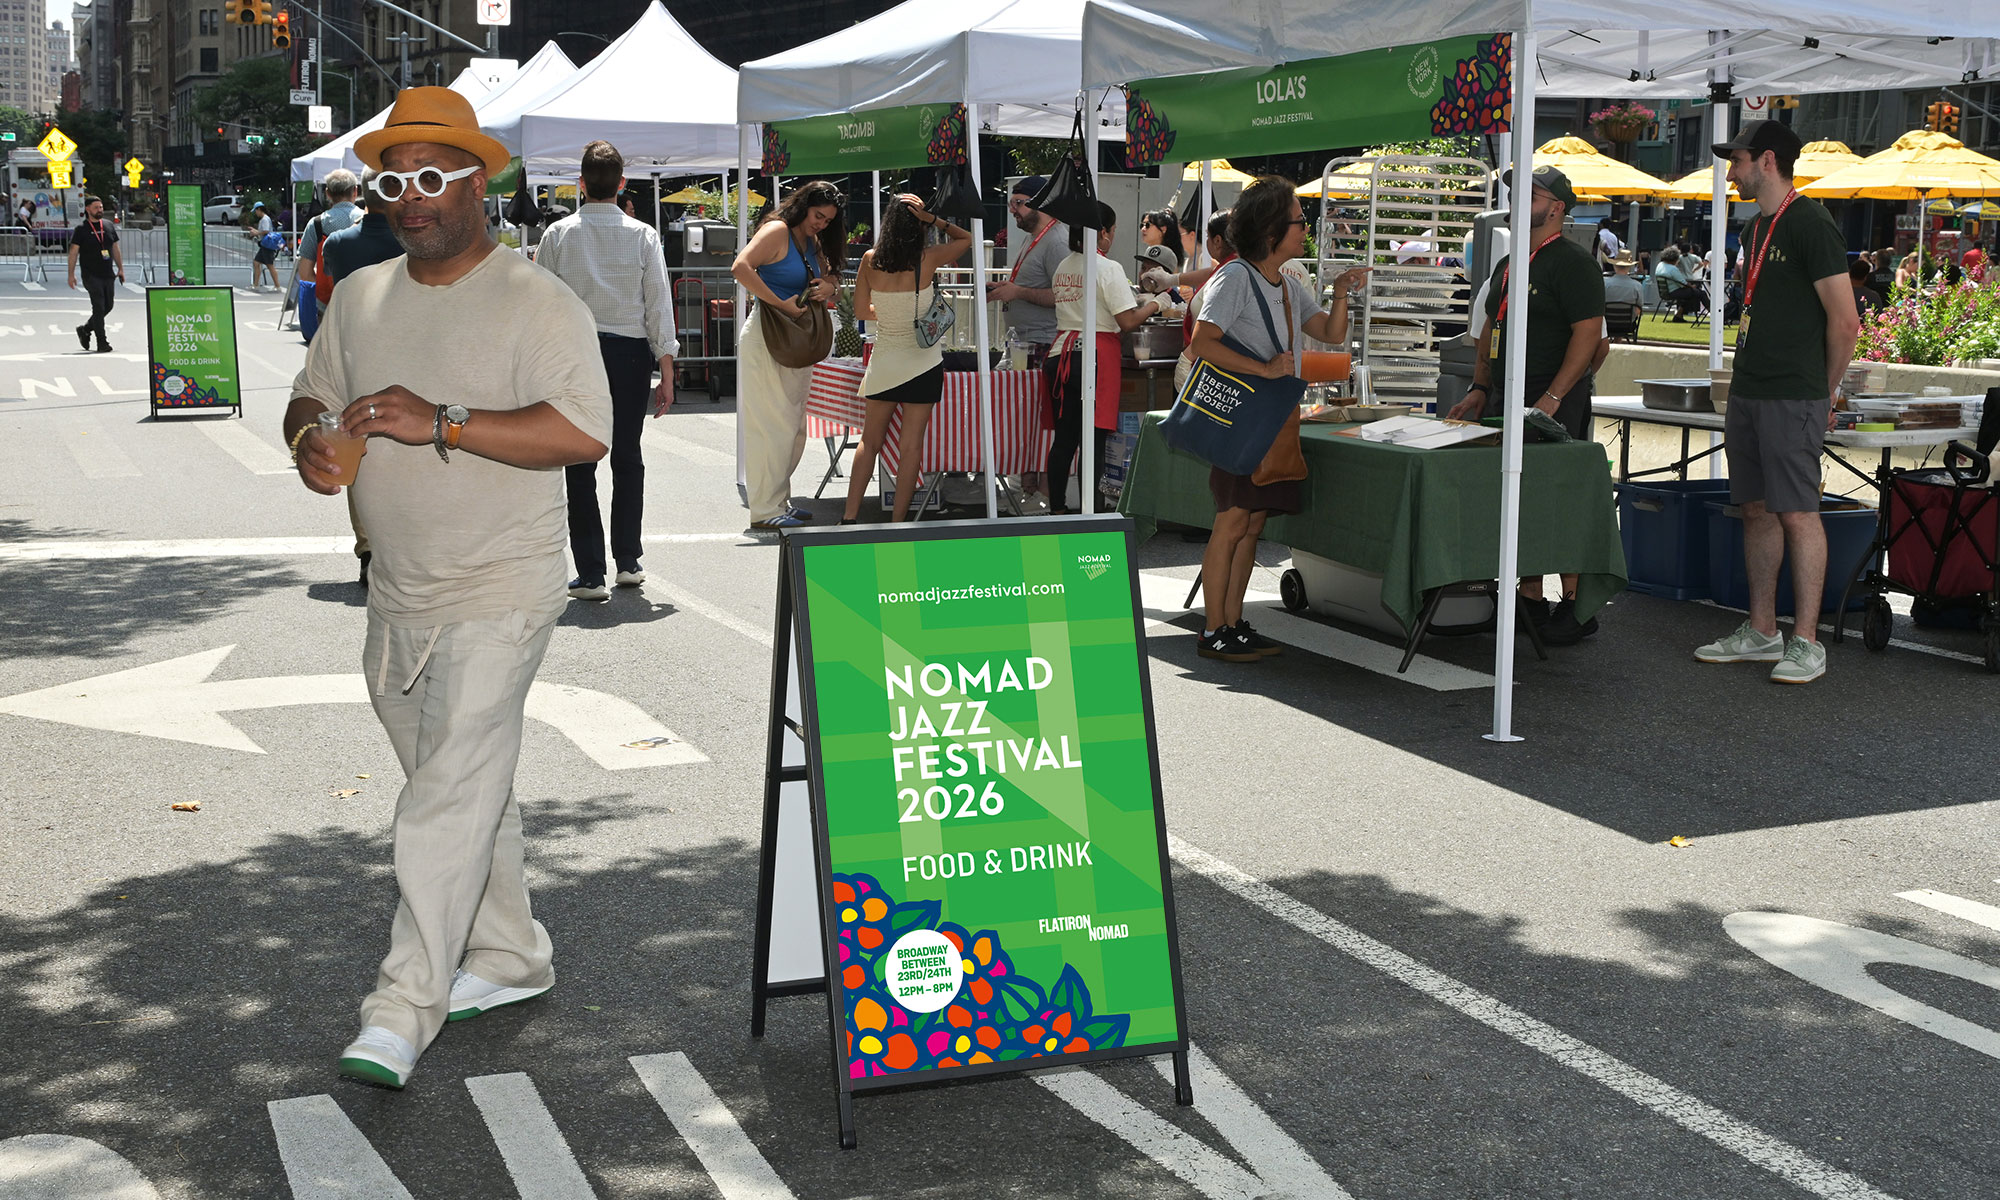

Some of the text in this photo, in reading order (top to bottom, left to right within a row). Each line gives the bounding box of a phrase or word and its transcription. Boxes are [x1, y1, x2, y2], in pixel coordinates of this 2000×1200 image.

[1415, 57, 1430, 75] NEW
[1414, 66, 1432, 85] YORK
[293, 94, 312, 102] Cure
[1256, 75, 1307, 104] LOLA'S
[314, 120, 326, 130] 10
[1251, 111, 1314, 127] NOMAD JAZZ FESTIVAL
[837, 120, 875, 140] TACOMBI
[166, 314, 212, 323] NOMAD
[167, 324, 194, 333] JAZZ
[168, 333, 219, 342] FESTIVAL
[168, 343, 198, 352] 2026
[169, 358, 189, 366] FOOD
[198, 357, 221, 365] DRINK
[1197, 381, 1242, 407] EQUALITY
[1201, 372, 1240, 398] TIBETAN
[1194, 389, 1234, 414] PROJECT
[1077, 554, 1111, 563] NOMAD
[877, 582, 1065, 605] nomadjazzfestival.com
[884, 656, 1053, 700] NOMAD
[888, 700, 991, 741] JAZZ
[892, 735, 1083, 782] FESTIVAL
[897, 781, 1005, 823] 2026
[902, 840, 1093, 882] FOOD & DRINK
[1038, 914, 1092, 934] FLATIRON
[1088, 924, 1129, 942] NOMAD
[897, 944, 948, 959] BROADWAY
[901, 956, 946, 970] BETWEEN
[897, 967, 952, 982] 23RD/24TH
[898, 985, 925, 997] 12PM
[933, 982, 954, 994] 8PM
